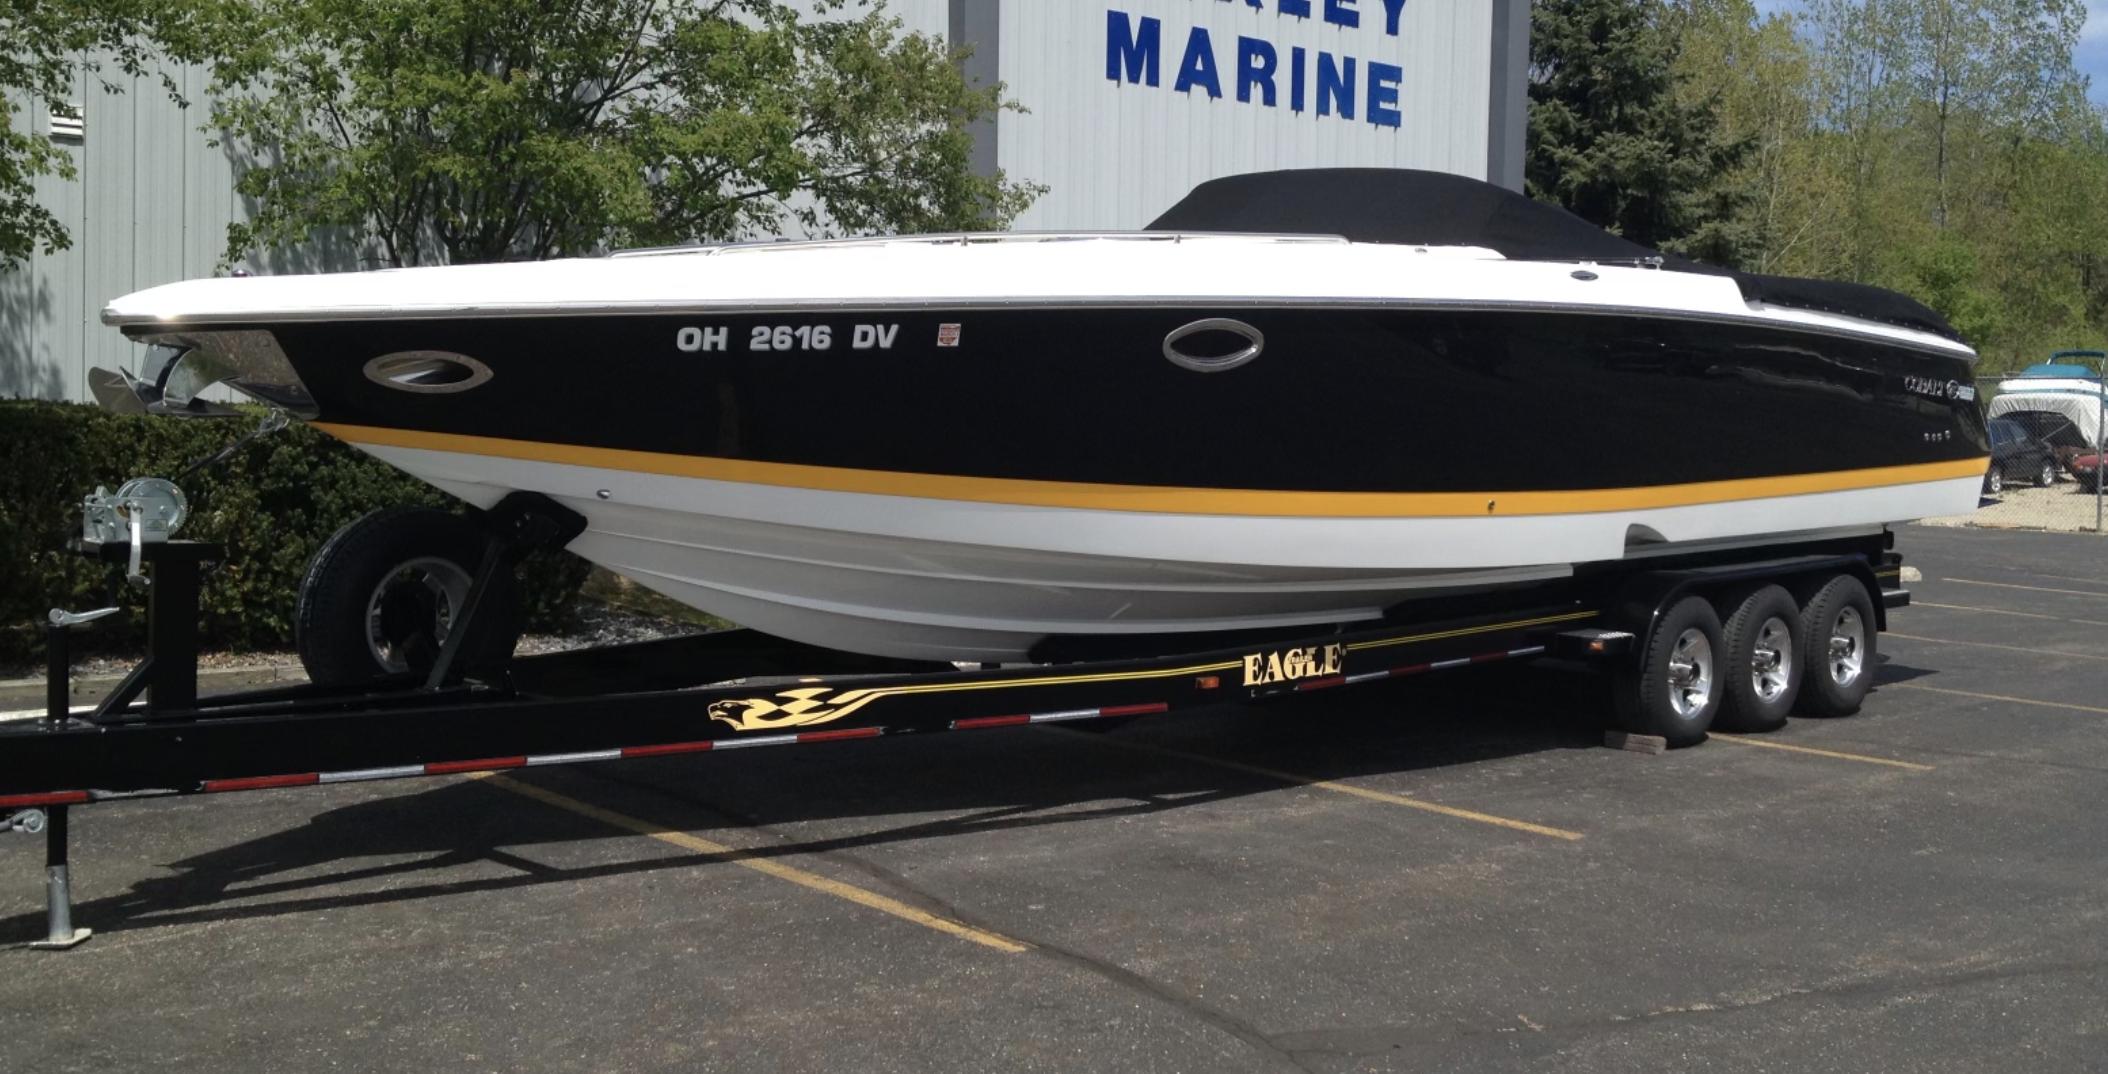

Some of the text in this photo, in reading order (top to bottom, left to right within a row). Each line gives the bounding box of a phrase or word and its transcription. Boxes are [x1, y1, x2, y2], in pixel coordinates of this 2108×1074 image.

[1106, 10, 1402, 128] MARINE
[677, 323, 900, 352] OH 2616 DV
[1243, 642, 1342, 687] EAGLE
